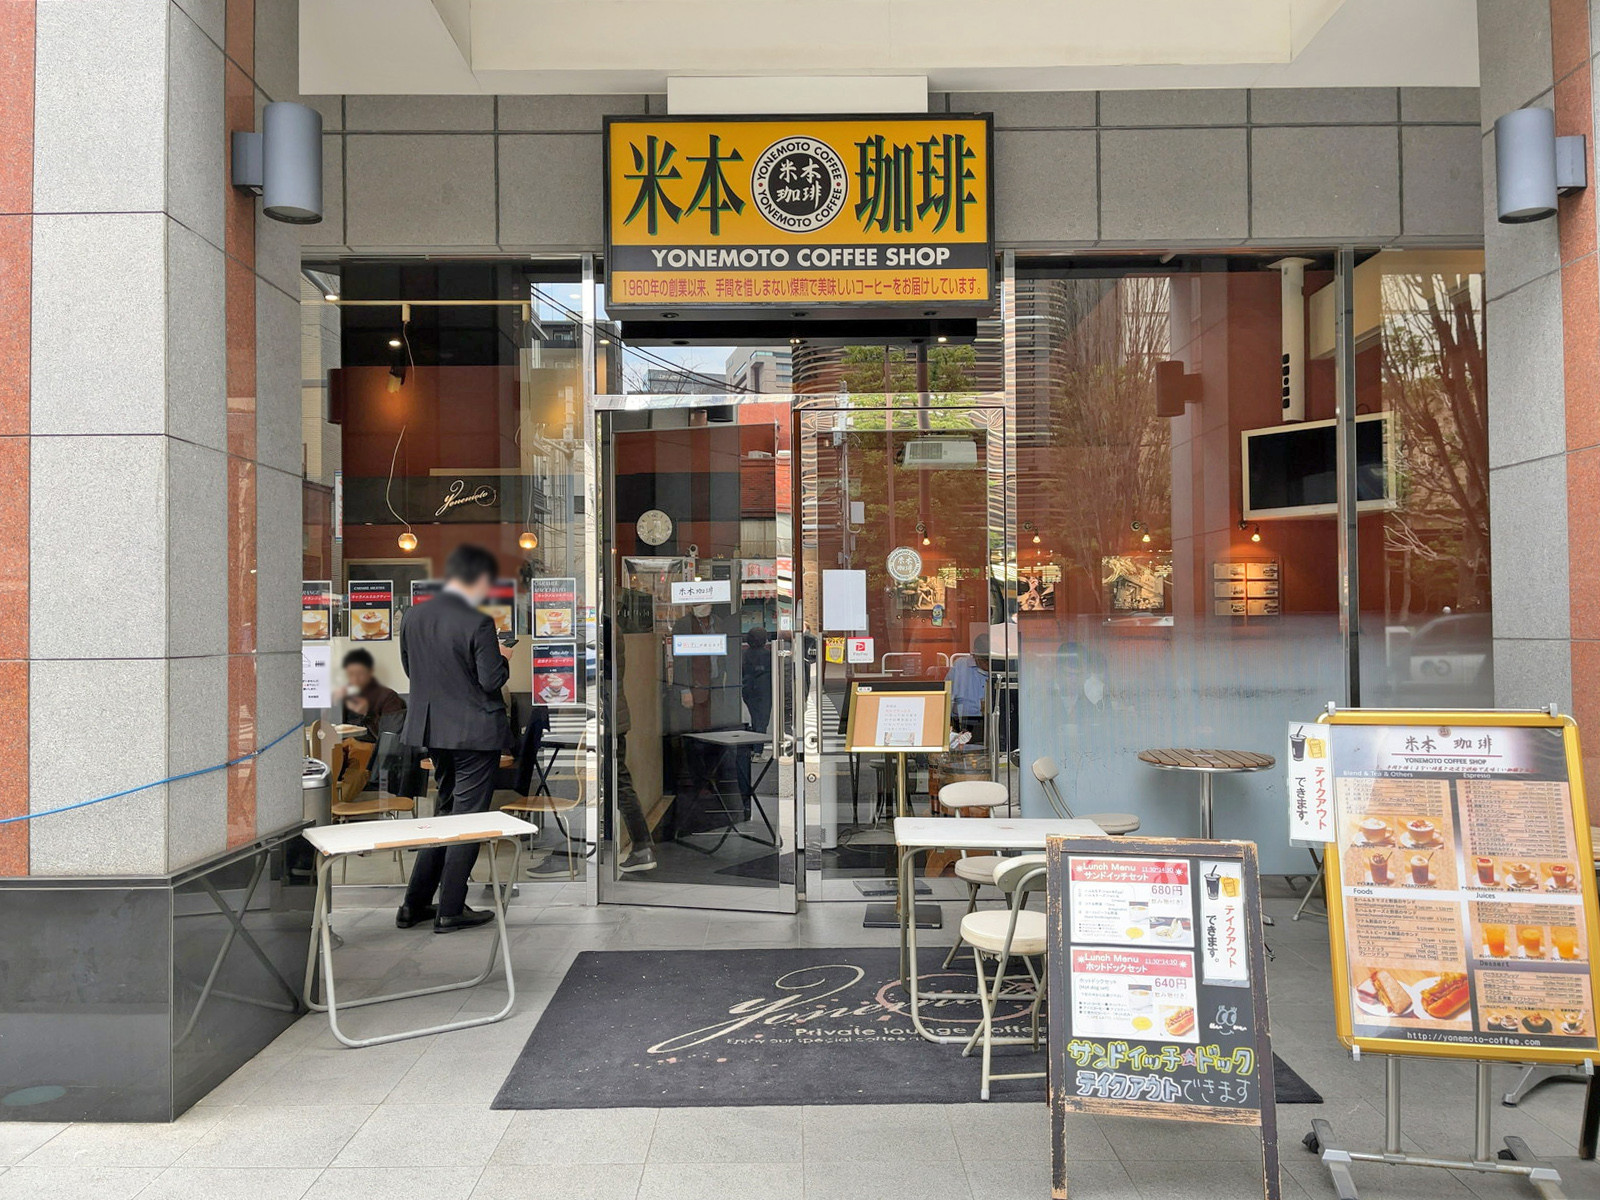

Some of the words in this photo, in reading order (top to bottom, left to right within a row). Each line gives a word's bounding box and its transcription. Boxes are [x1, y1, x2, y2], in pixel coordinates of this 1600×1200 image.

[757, 142, 810, 181] YONEMOTO
[814, 147, 842, 180] COFFEE
[779, 158, 821, 183] 米本
[623, 134, 746, 235] 米本
[854, 134, 977, 234] 珈琲
[776, 181, 822, 209] 珈琲
[758, 189, 812, 227] YONEMOTO
[815, 188, 842, 222] COFFEE
[652, 249, 790, 268] YONEMOTO
[796, 248, 878, 267] COFFEE
[886, 247, 950, 266] SHOP
[1405, 735, 1437, 753] 米本
[1454, 734, 1493, 754] 珈琲
[1295, 777, 1310, 825] できます。
[1315, 767, 1327, 830] テイクアウト
[1082, 862, 1108, 871] Lunch
[1111, 863, 1136, 872] Menu
[1084, 872, 1149, 881] サンドイッチセット
[1151, 885, 1183, 896] 680円
[1206, 915, 1219, 962] できます。
[1224, 905, 1237, 968] テイクアウト
[1084, 953, 1110, 962] Lunch
[1113, 954, 1139, 963] Menu
[1086, 963, 1148, 973] ホットドックセット
[1154, 978, 1187, 989] 640円
[795, 1027, 876, 1036] Private
[1407, 1031, 1541, 1047] http://yonemoto-coffee.com
[1076, 1070, 1251, 1104] テイクアウトできます
